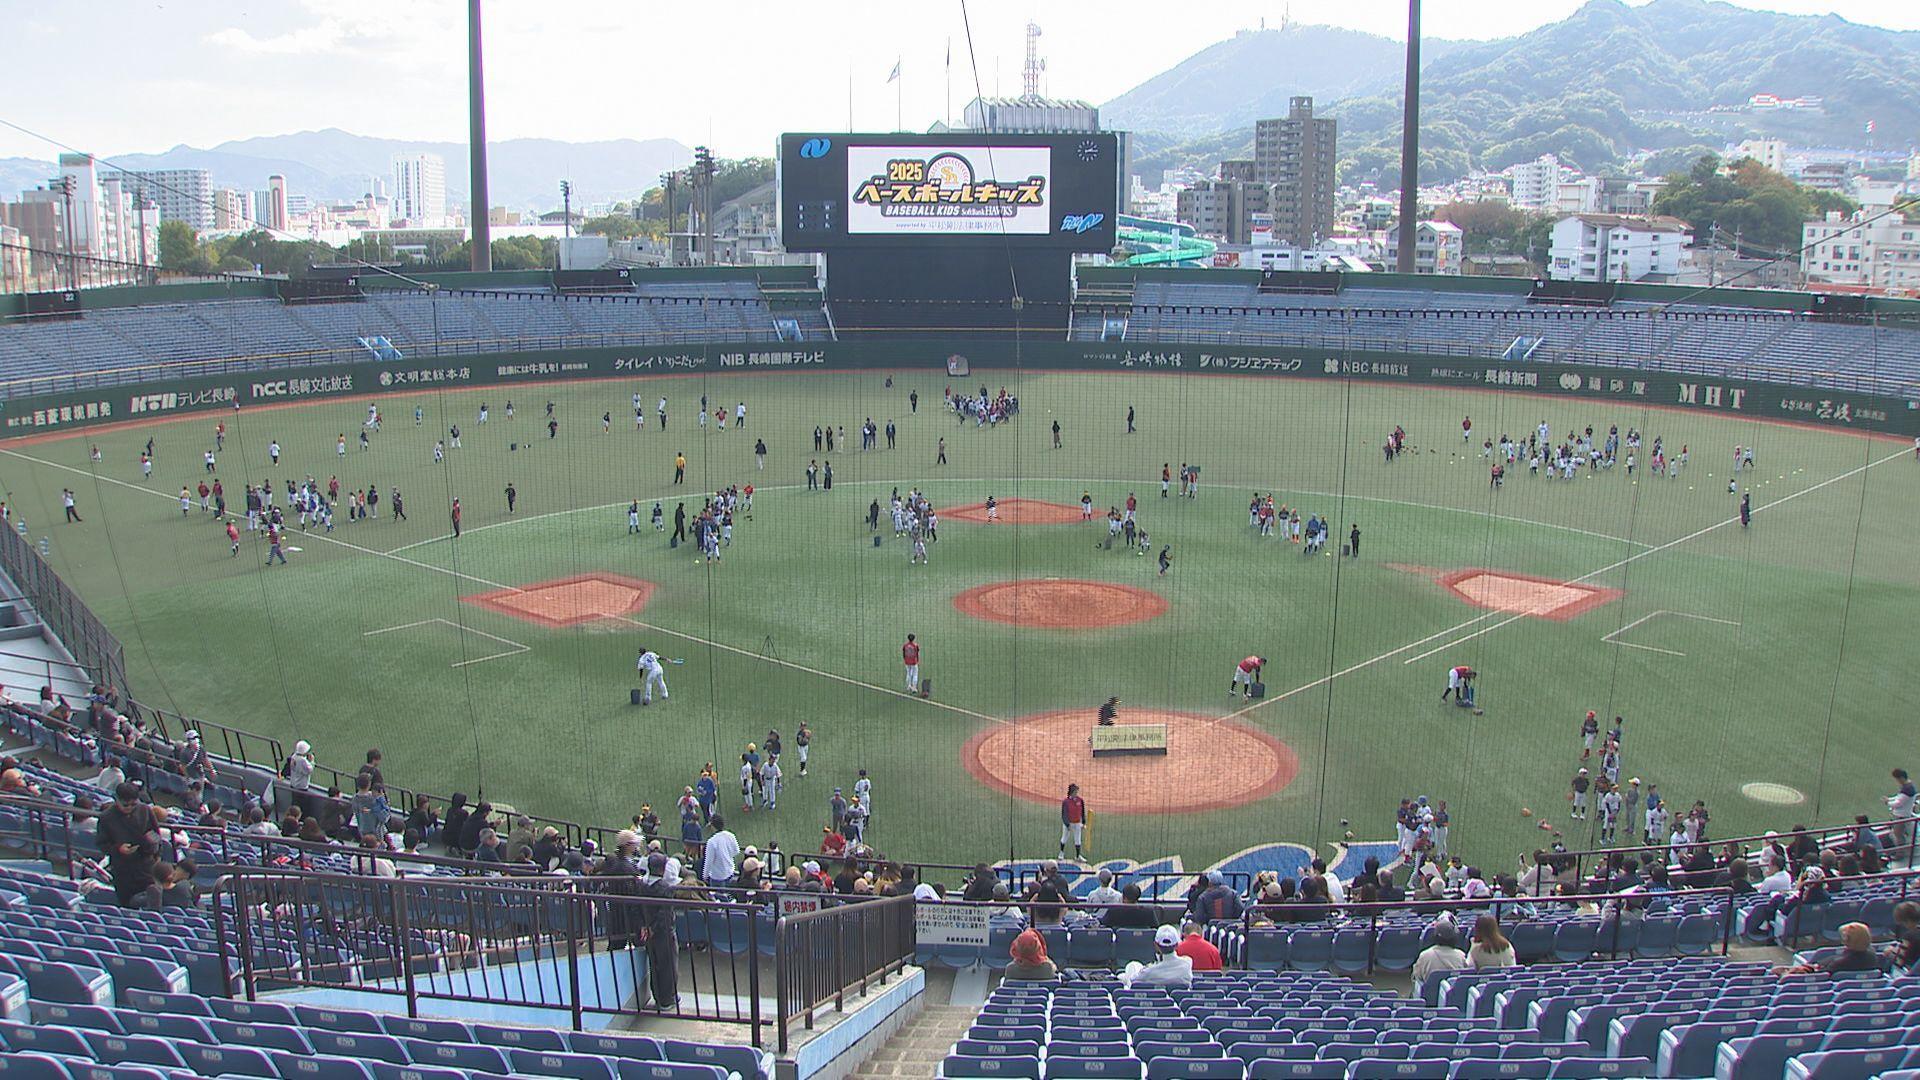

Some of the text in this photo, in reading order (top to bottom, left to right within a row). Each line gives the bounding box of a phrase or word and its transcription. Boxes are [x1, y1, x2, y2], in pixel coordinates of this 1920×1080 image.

[890, 163, 923, 181] 2025
[857, 178, 1042, 203] ベースボールキッズ
[886, 205, 935, 216] BASEBALL
[936, 205, 960, 216] KIDS
[985, 205, 1013, 216] HAWKS
[619, 270, 629, 278] 20
[65, 293, 75, 301] 22
[614, 356, 654, 371] タイレイ
[720, 351, 825, 367] NIB 長崎国際テレビ
[393, 366, 471, 384] 文明堂総本店
[1342, 360, 1409, 377] NBC 長崎放送
[288, 374, 353, 396] 長崎文化放送
[1484, 369, 1538, 387] 長崎新聞
[177, 386, 236, 408] テレビ長崎
[1677, 383, 1746, 410] MHT
